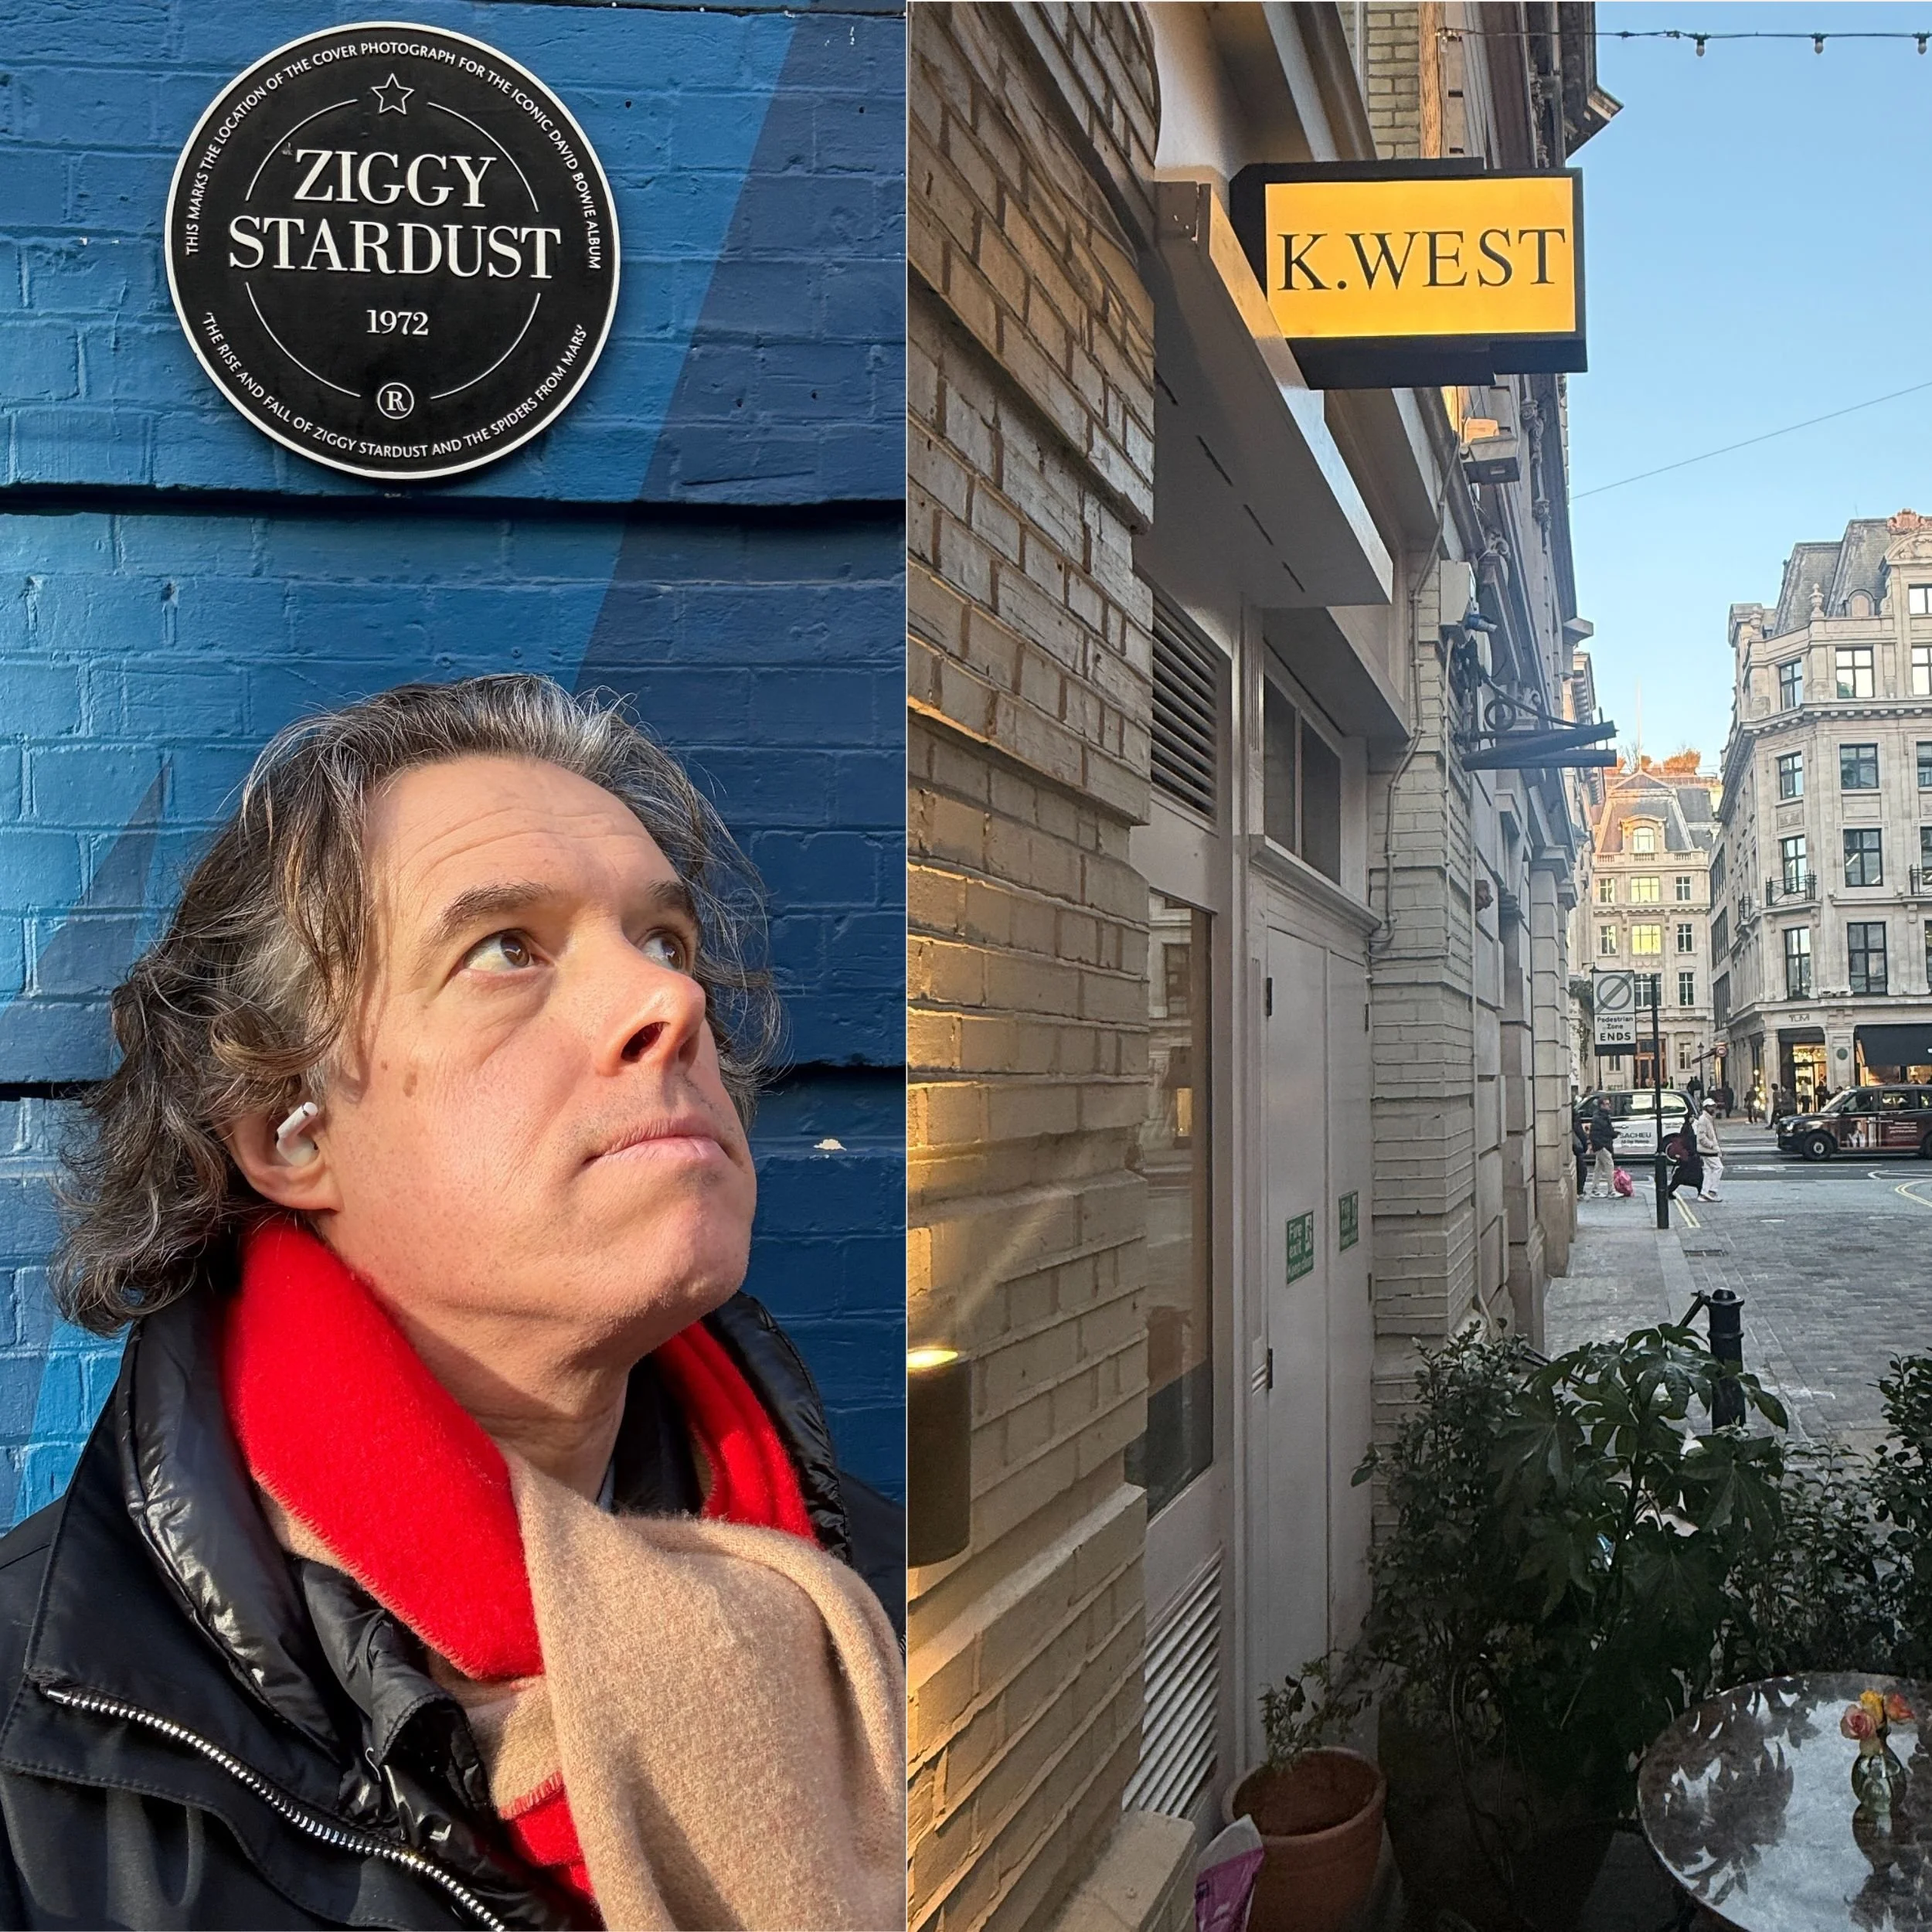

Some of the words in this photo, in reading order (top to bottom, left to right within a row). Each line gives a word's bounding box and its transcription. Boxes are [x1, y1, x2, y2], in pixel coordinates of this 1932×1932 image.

[312, 44, 358, 66] COVER
[360, 42, 456, 65] PHOTOGRAPH
[282, 58, 312, 78] THE
[458, 56, 485, 78] FOR
[266, 72, 284, 90] OF
[487, 70, 512, 94] THE
[213, 86, 267, 145] LOCATION
[510, 88, 553, 131] ICONIC
[199, 144, 222, 169] THE
[548, 129, 578, 170] DAVID
[294, 148, 497, 208] ZIGGY
[187, 172, 209, 219] MARKS
[572, 172, 597, 218] BOWIE
[185, 223, 199, 255] THIS
[229, 216, 562, 280] STARDUST
[586, 220, 601, 269] ALBUM
[1278, 230, 1565, 290] K.WEST
[367, 310, 428, 335] 1972
[216, 343, 242, 372] RISE
[236, 372, 264, 398] AND
[263, 395, 291, 423] FALL
[293, 417, 314, 433] OF
[312, 427, 357, 451] ZIGGY
[359, 441, 428, 458] STARDUST
[432, 439, 462, 455] AND
[462, 427, 492, 447] THE
[490, 397, 538, 435] SPIDERS
[534, 366, 567, 401] FROM
[1789, 1013, 1810, 1022] TUMI
[1600, 1032, 1631, 1041] ENDS
[1289, 1223, 1302, 1241] Fire
[1289, 1243, 1301, 1259] exit
